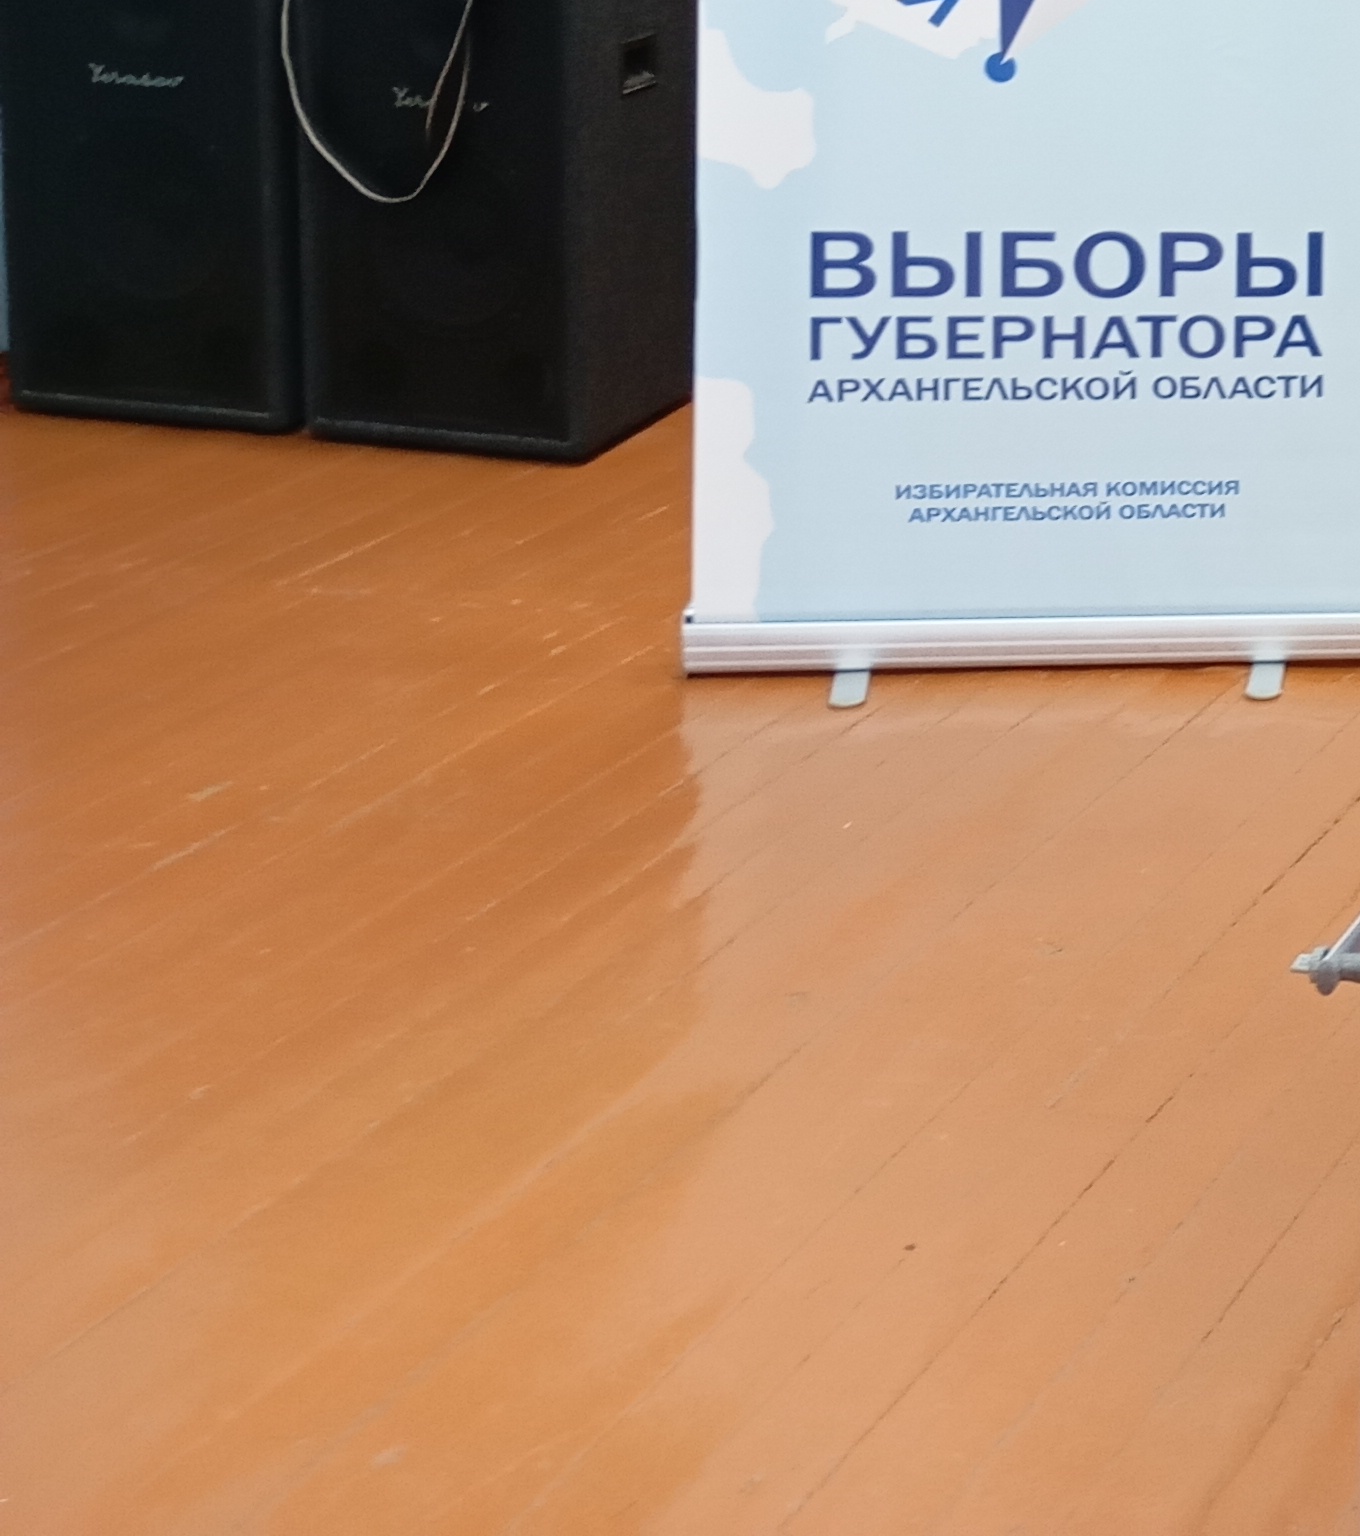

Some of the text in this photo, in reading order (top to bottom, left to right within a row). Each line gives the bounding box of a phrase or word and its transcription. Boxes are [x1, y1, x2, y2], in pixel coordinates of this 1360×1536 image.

[808, 230, 1325, 299] ВЫБОРЫ
[808, 314, 1323, 361] ГУБЕРНАТОРА
[806, 370, 1325, 403] АРХАНГЕЛЬСКОЙ ОБЛАСТИ
[894, 479, 1240, 500] ИЗБИРАТЕЛЬНАЯ КОМИССИЯ
[907, 500, 1226, 524] АРХАНГЕЛЬСКОЙ ОБЛАСТИ
